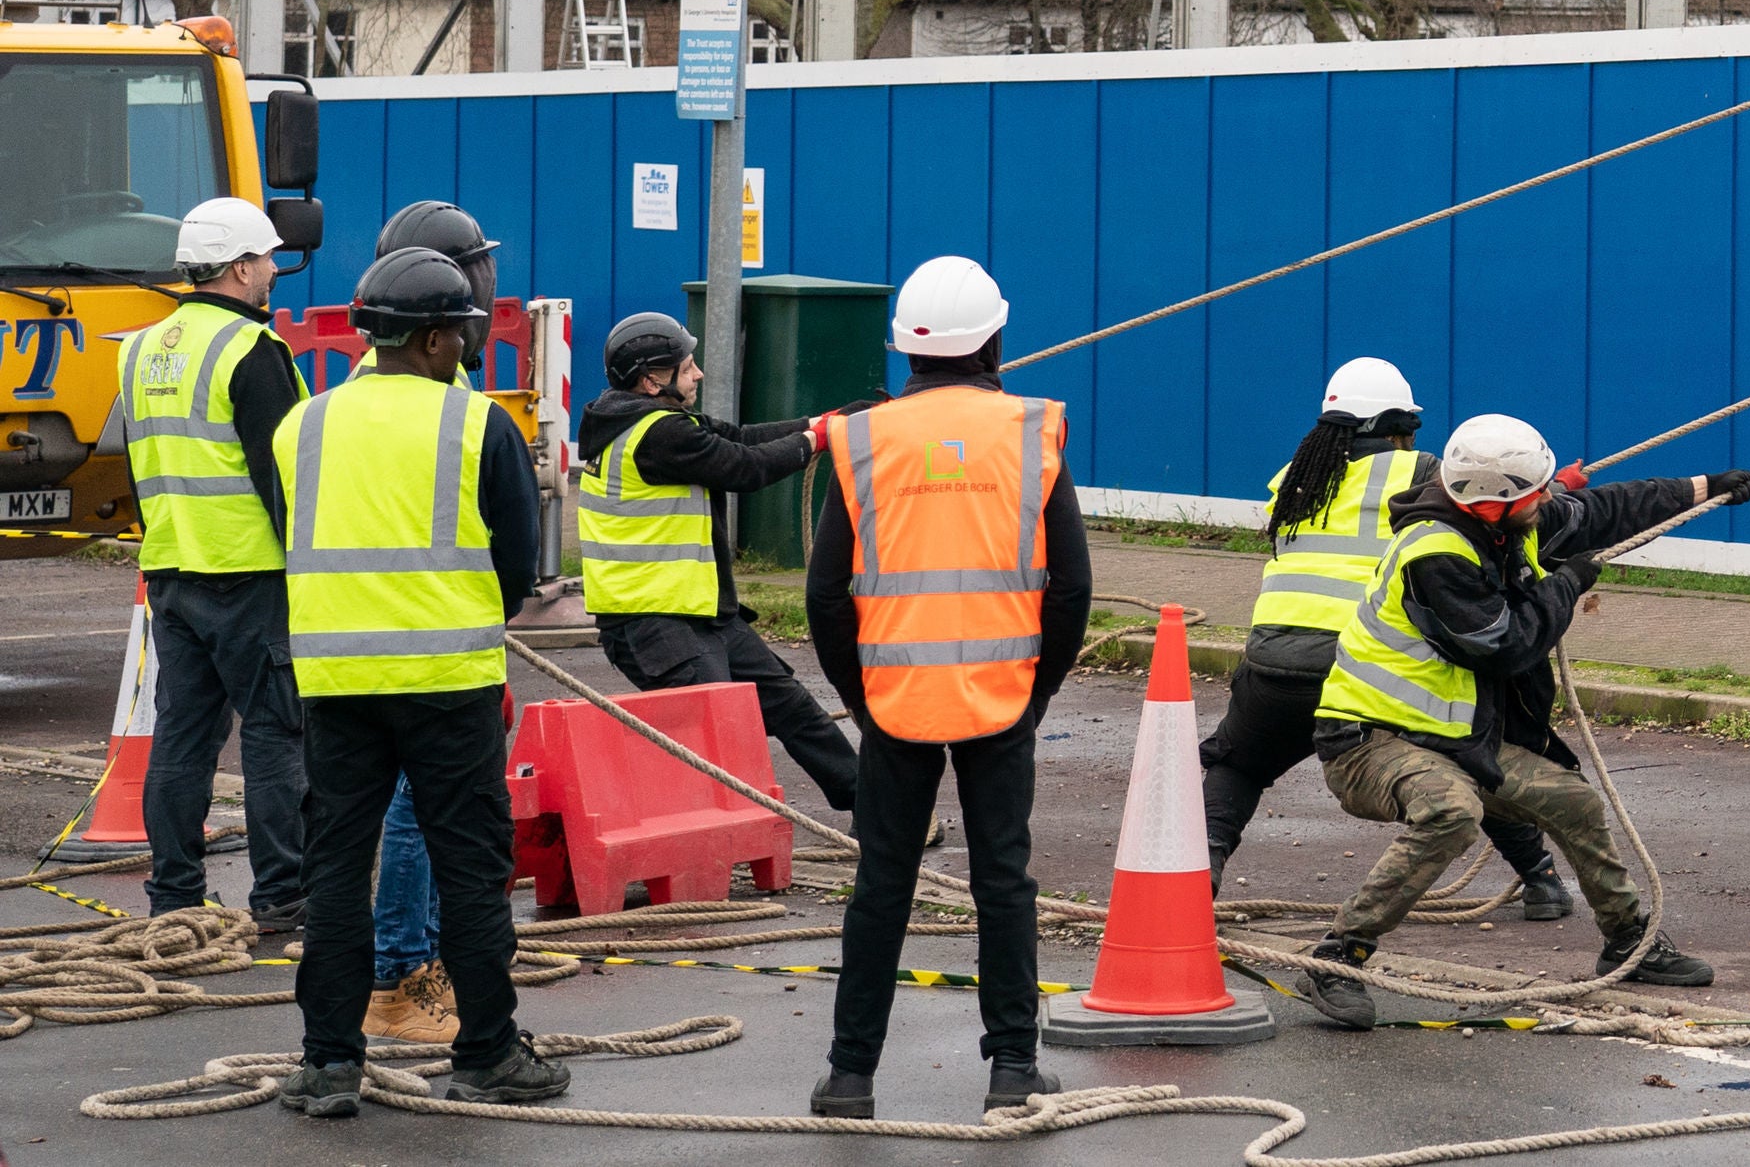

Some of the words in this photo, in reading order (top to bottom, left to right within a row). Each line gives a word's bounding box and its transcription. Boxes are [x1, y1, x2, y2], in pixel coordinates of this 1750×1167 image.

[955, 483, 968, 492] DE
[970, 483, 998, 493] BOER
[8, 492, 56, 517] MXW
